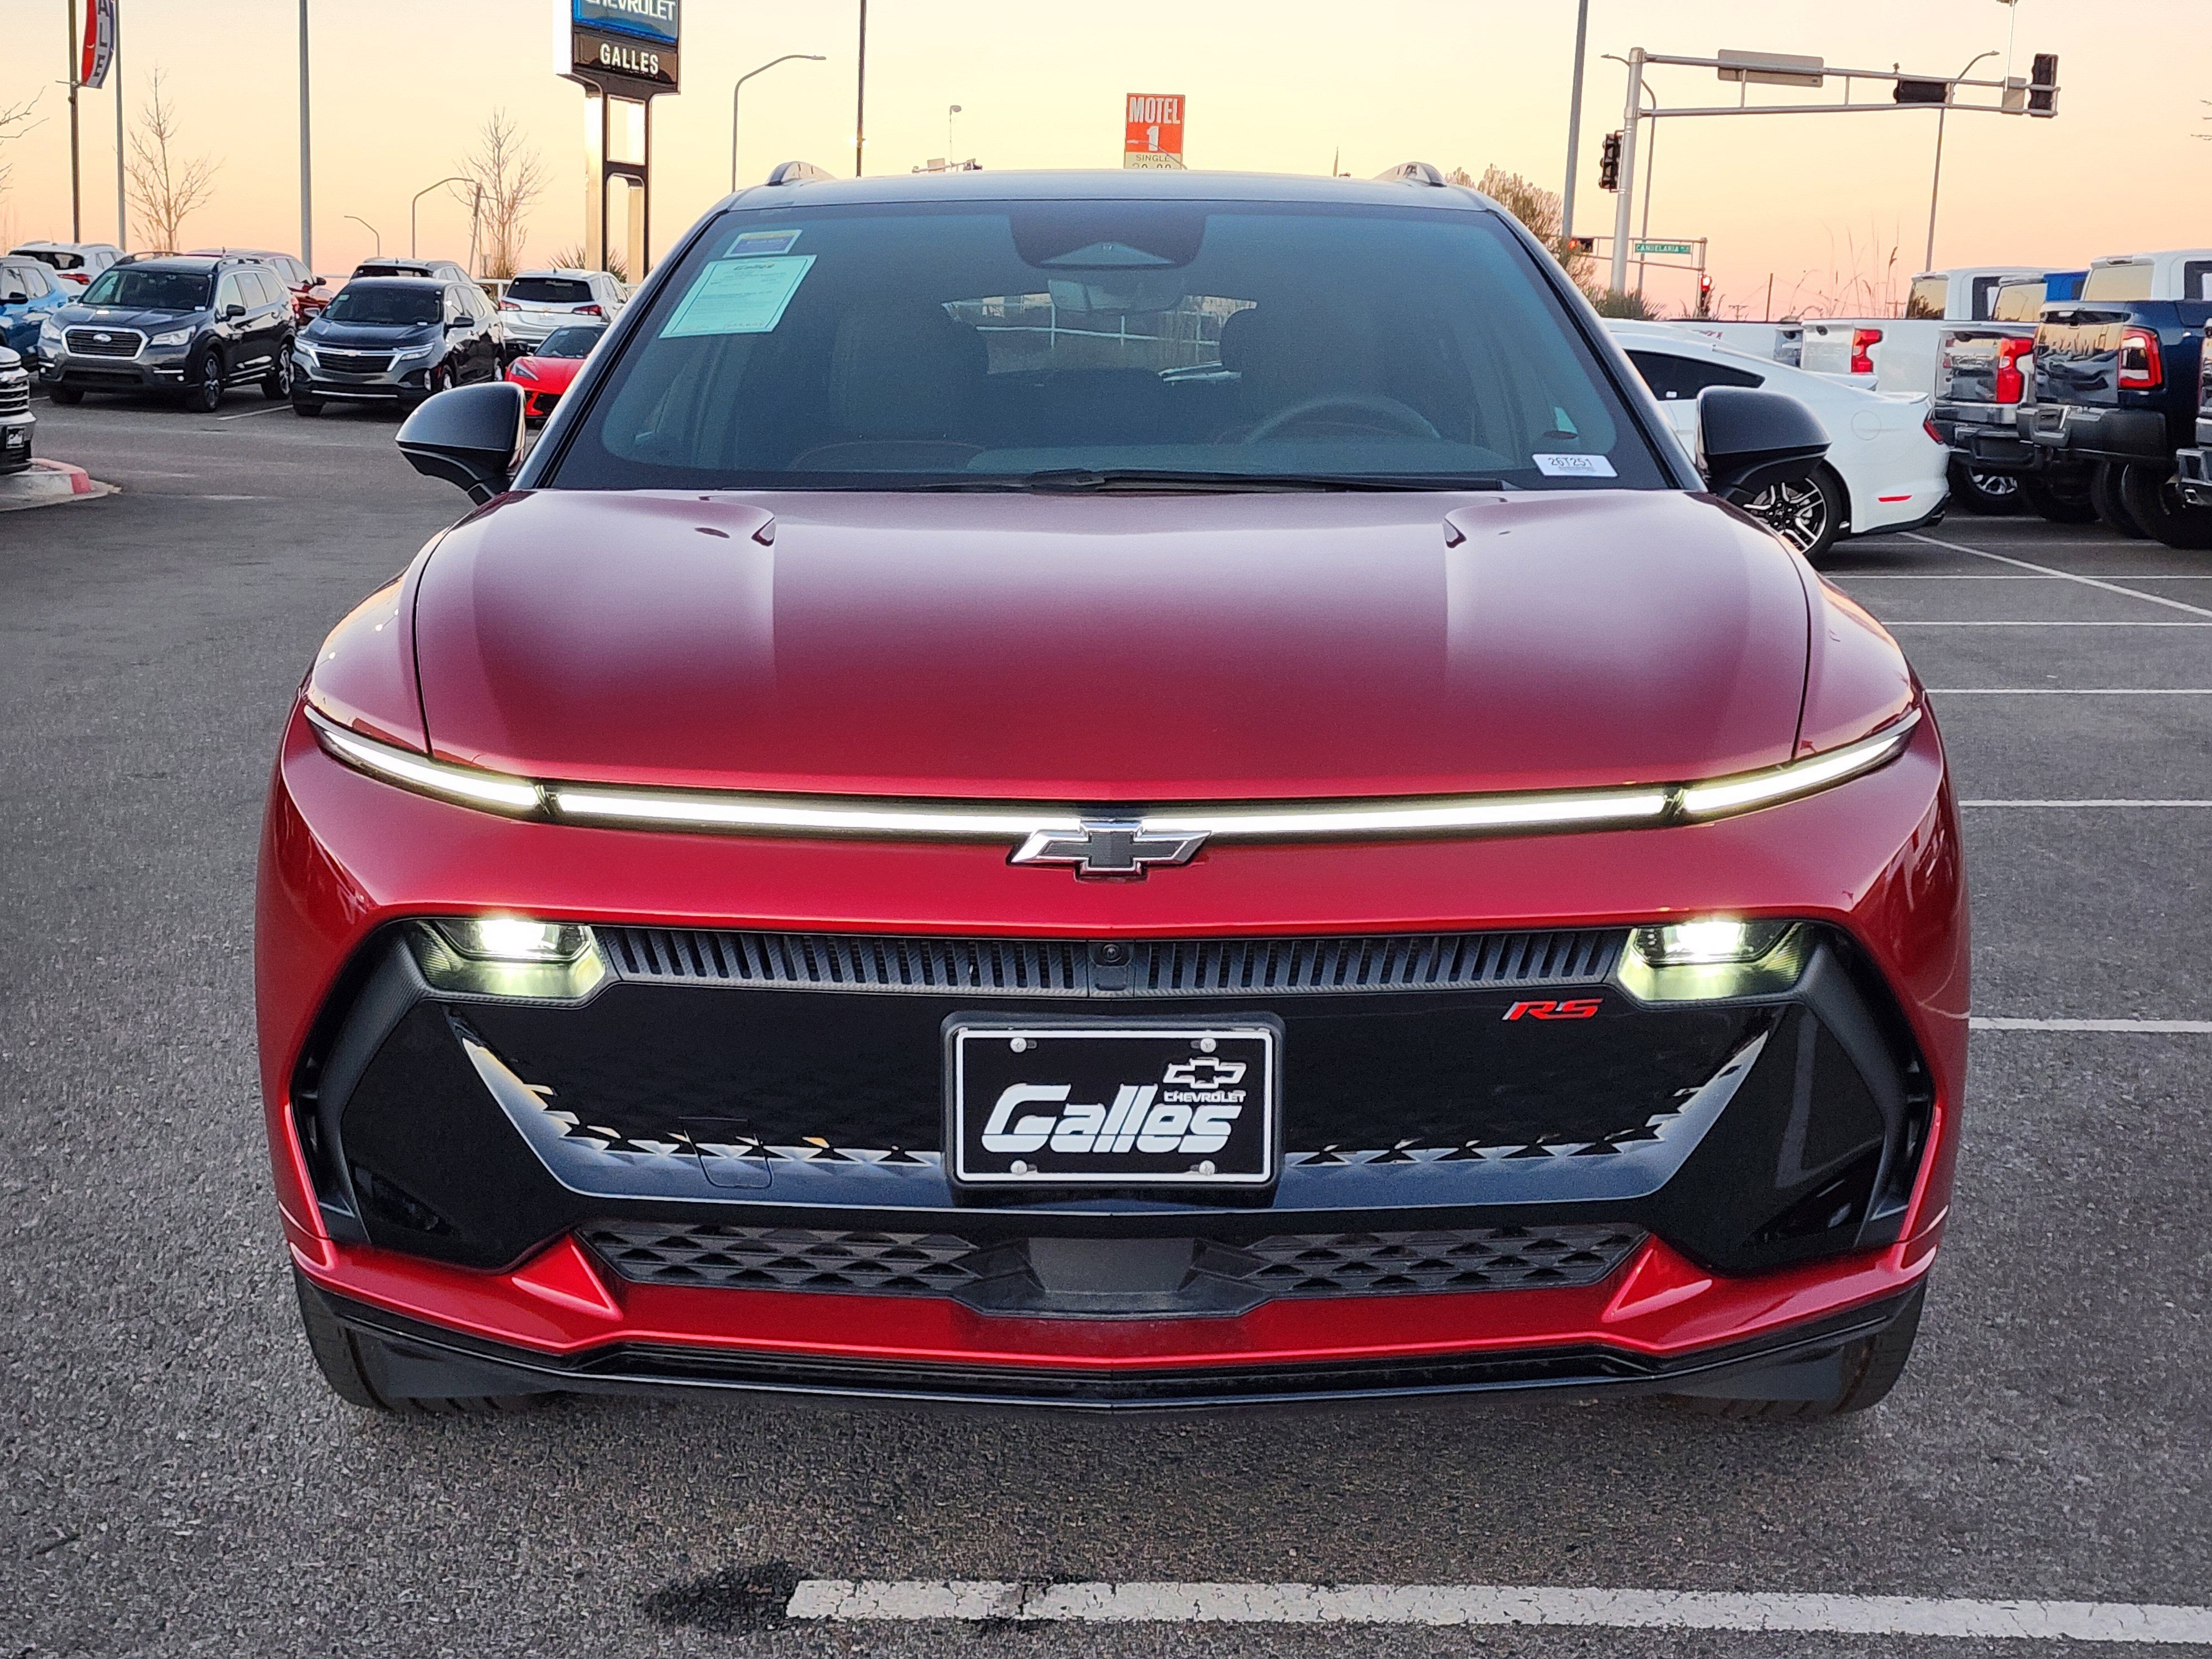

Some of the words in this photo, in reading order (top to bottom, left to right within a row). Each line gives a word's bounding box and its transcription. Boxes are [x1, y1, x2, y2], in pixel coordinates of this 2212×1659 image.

[584, 0, 676, 20] VROLET
[600, 43, 659, 75] GALLES
[1129, 97, 1181, 124] MOTEL
[1146, 126, 1159, 151] 1
[1502, 998, 1603, 1020] RS
[1164, 1090, 1246, 1103] CHEVROLET
[982, 1083, 1242, 1153] Galles
